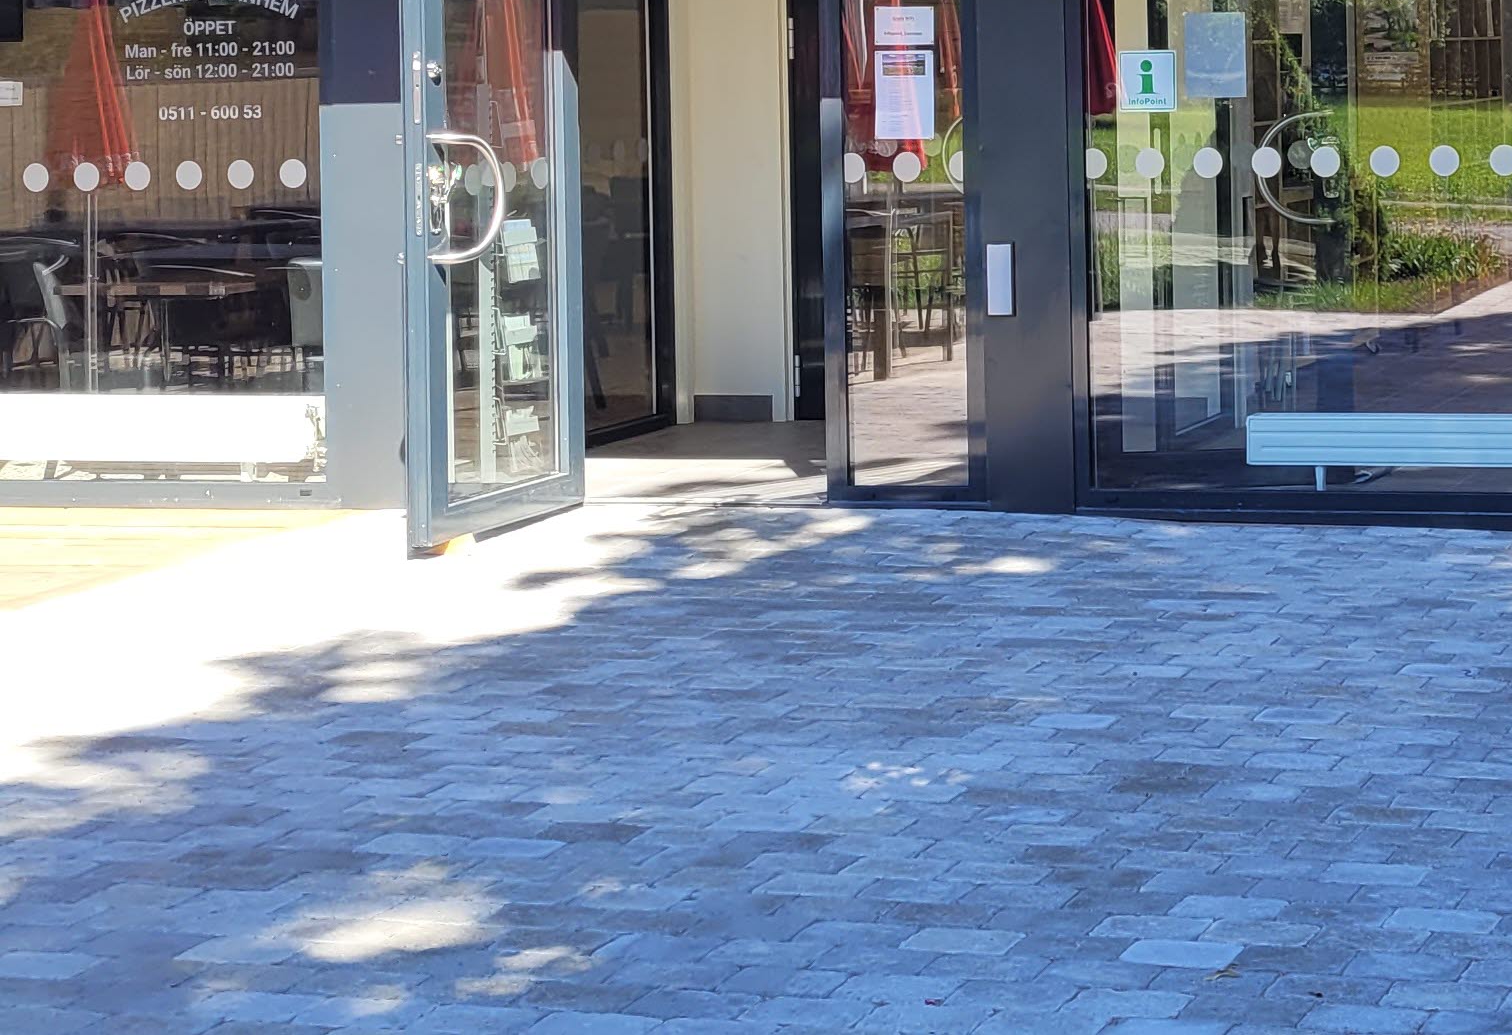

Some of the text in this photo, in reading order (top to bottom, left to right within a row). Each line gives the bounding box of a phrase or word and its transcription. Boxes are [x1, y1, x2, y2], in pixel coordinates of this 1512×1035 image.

[183, 17, 237, 36] ÖPPET
[124, 43, 157, 59] Man
[171, 42, 193, 58] fre
[196, 41, 238, 57] 11:00
[252, 40, 295, 56] 21:00
[126, 65, 151, 81] Lör
[164, 64, 191, 79] sön
[195, 63, 237, 78] 12:00
[251, 62, 295, 77] 21:00
[1128, 97, 1167, 106] InfoPoint
[158, 105, 195, 121] 0511
[210, 104, 239, 120] 600
[242, 104, 262, 120] 53
